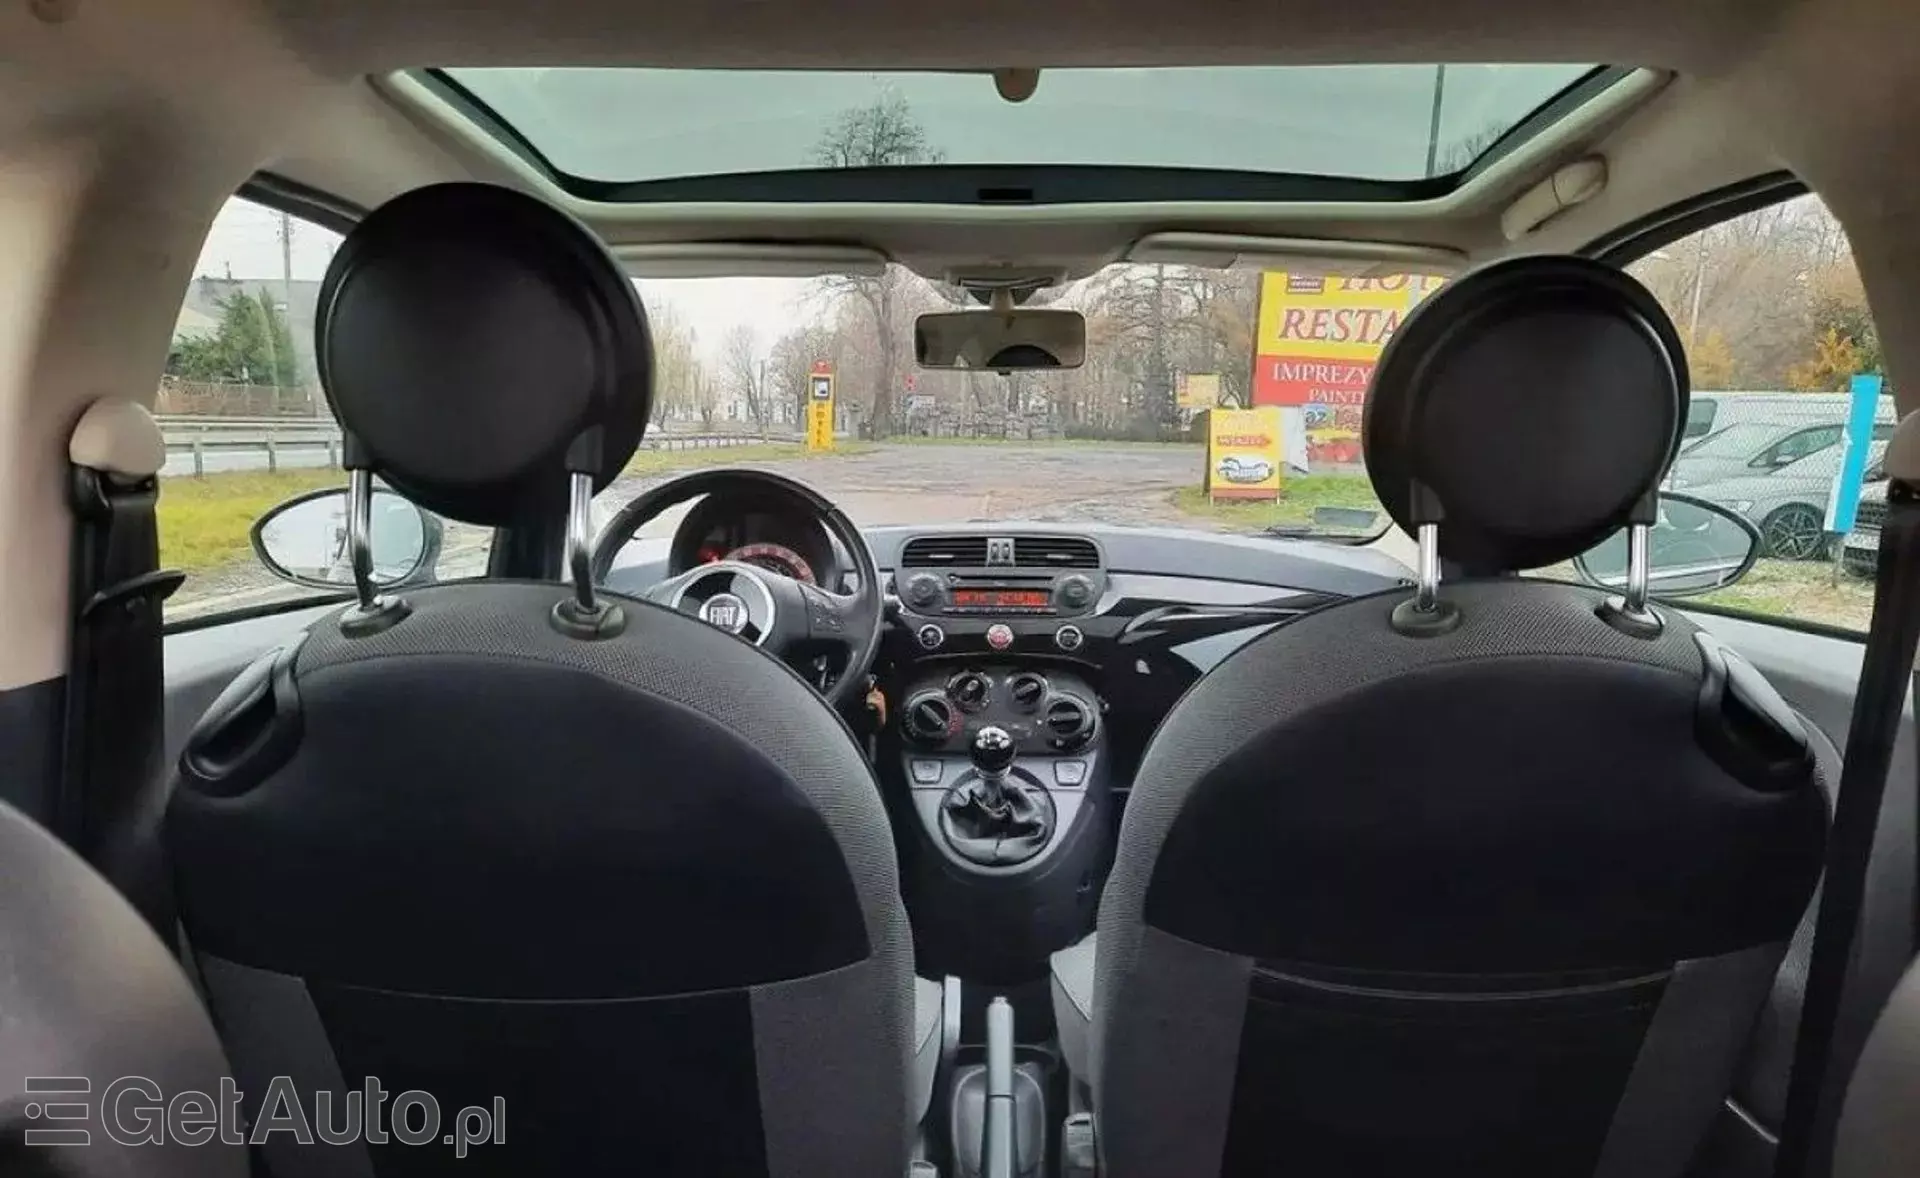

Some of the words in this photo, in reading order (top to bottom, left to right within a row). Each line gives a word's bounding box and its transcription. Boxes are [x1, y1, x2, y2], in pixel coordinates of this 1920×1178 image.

[1273, 362, 1371, 385] IMPREZY
[1309, 387, 1365, 405] PAINT
[711, 606, 737, 625] FIAT
